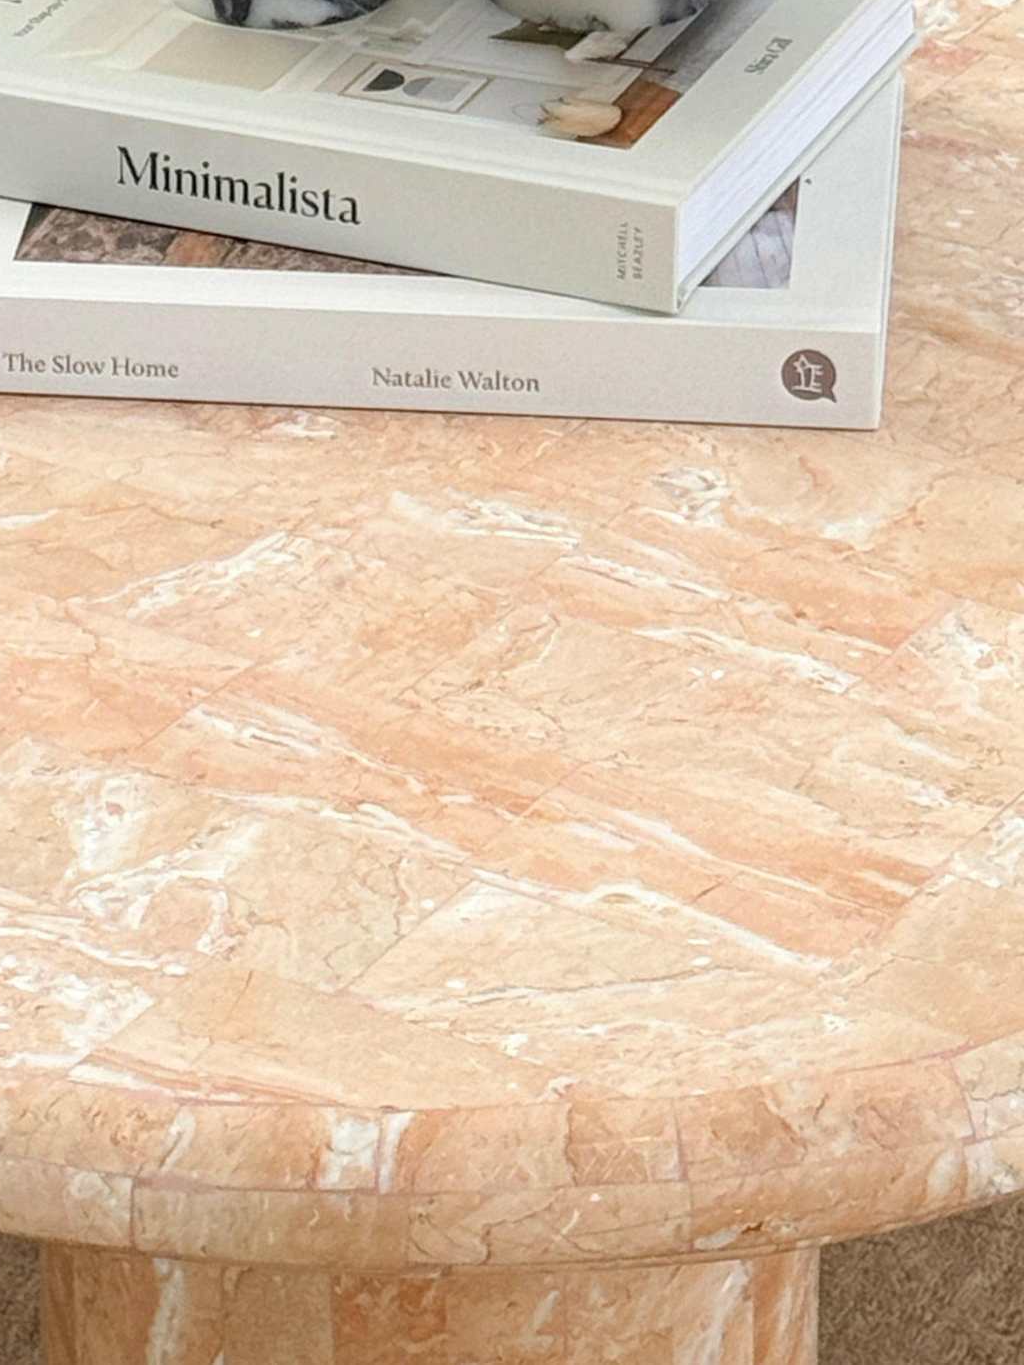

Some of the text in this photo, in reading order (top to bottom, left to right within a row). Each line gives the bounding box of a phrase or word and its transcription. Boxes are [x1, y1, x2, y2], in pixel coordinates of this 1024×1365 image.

[117, 146, 362, 226] Minimalista
[616, 221, 629, 280] MITCHELL
[4, 352, 48, 375] The
[52, 354, 107, 378] Slow
[111, 356, 180, 379] Home
[373, 367, 453, 390] Natalie
[458, 370, 541, 393] Walton
